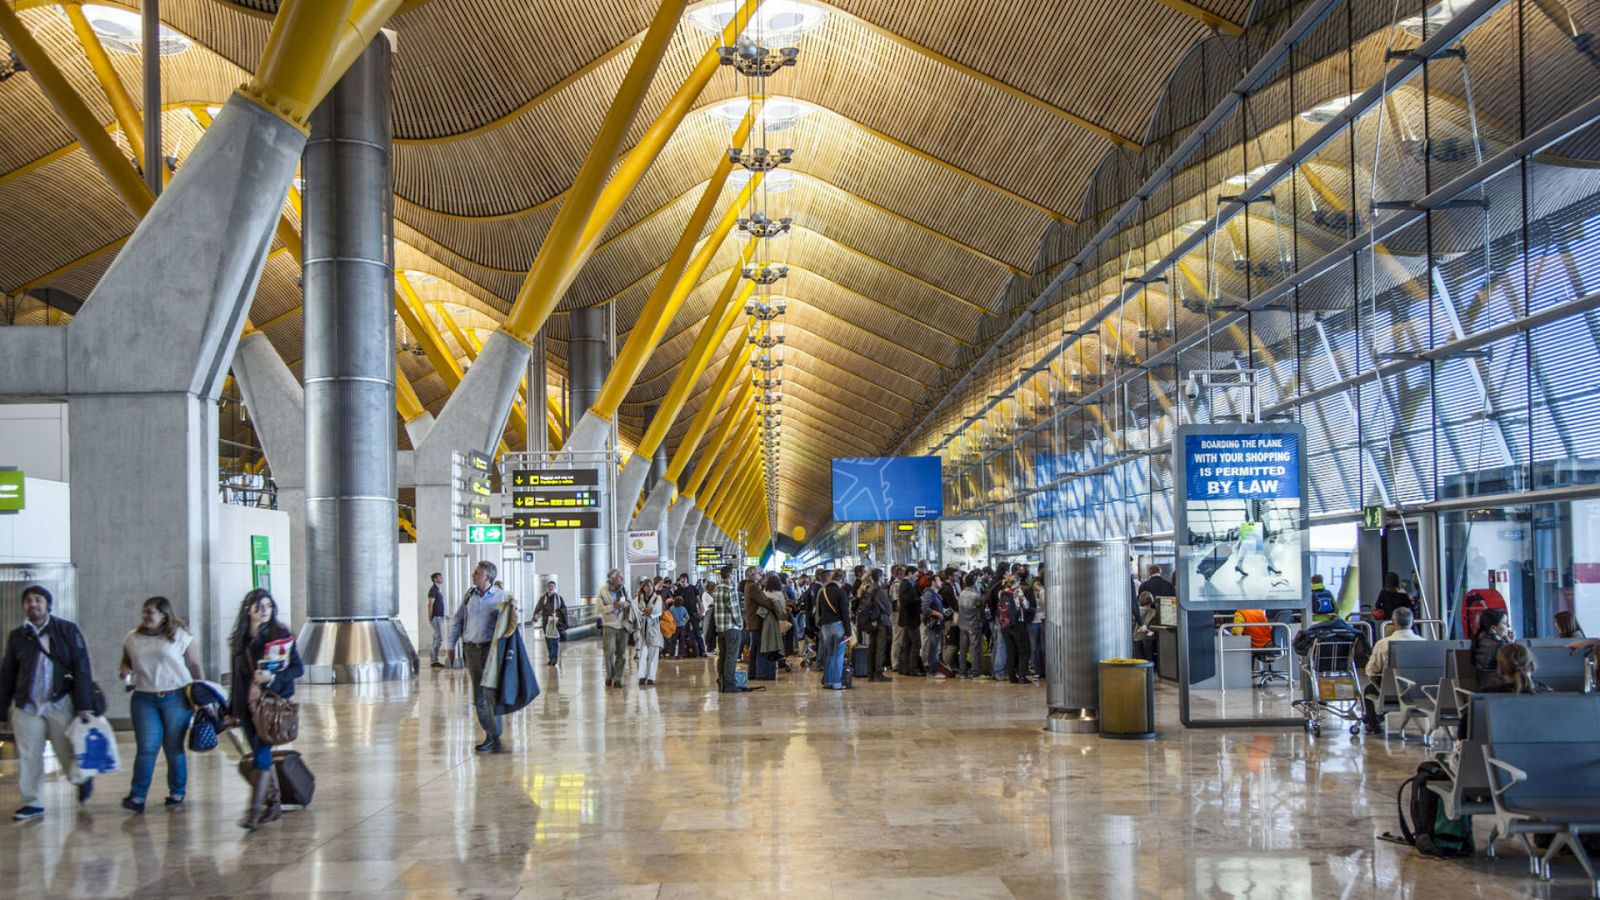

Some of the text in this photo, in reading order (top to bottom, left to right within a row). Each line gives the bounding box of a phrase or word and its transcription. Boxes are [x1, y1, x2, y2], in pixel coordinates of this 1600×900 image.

[1201, 439, 1282, 448] BOARDING THE PLANE
[1194, 452, 1290, 463] WITH YOUR SHOPPING
[1200, 466, 1286, 477] IS PERMITTED
[1208, 480, 1278, 494] BY LAW
